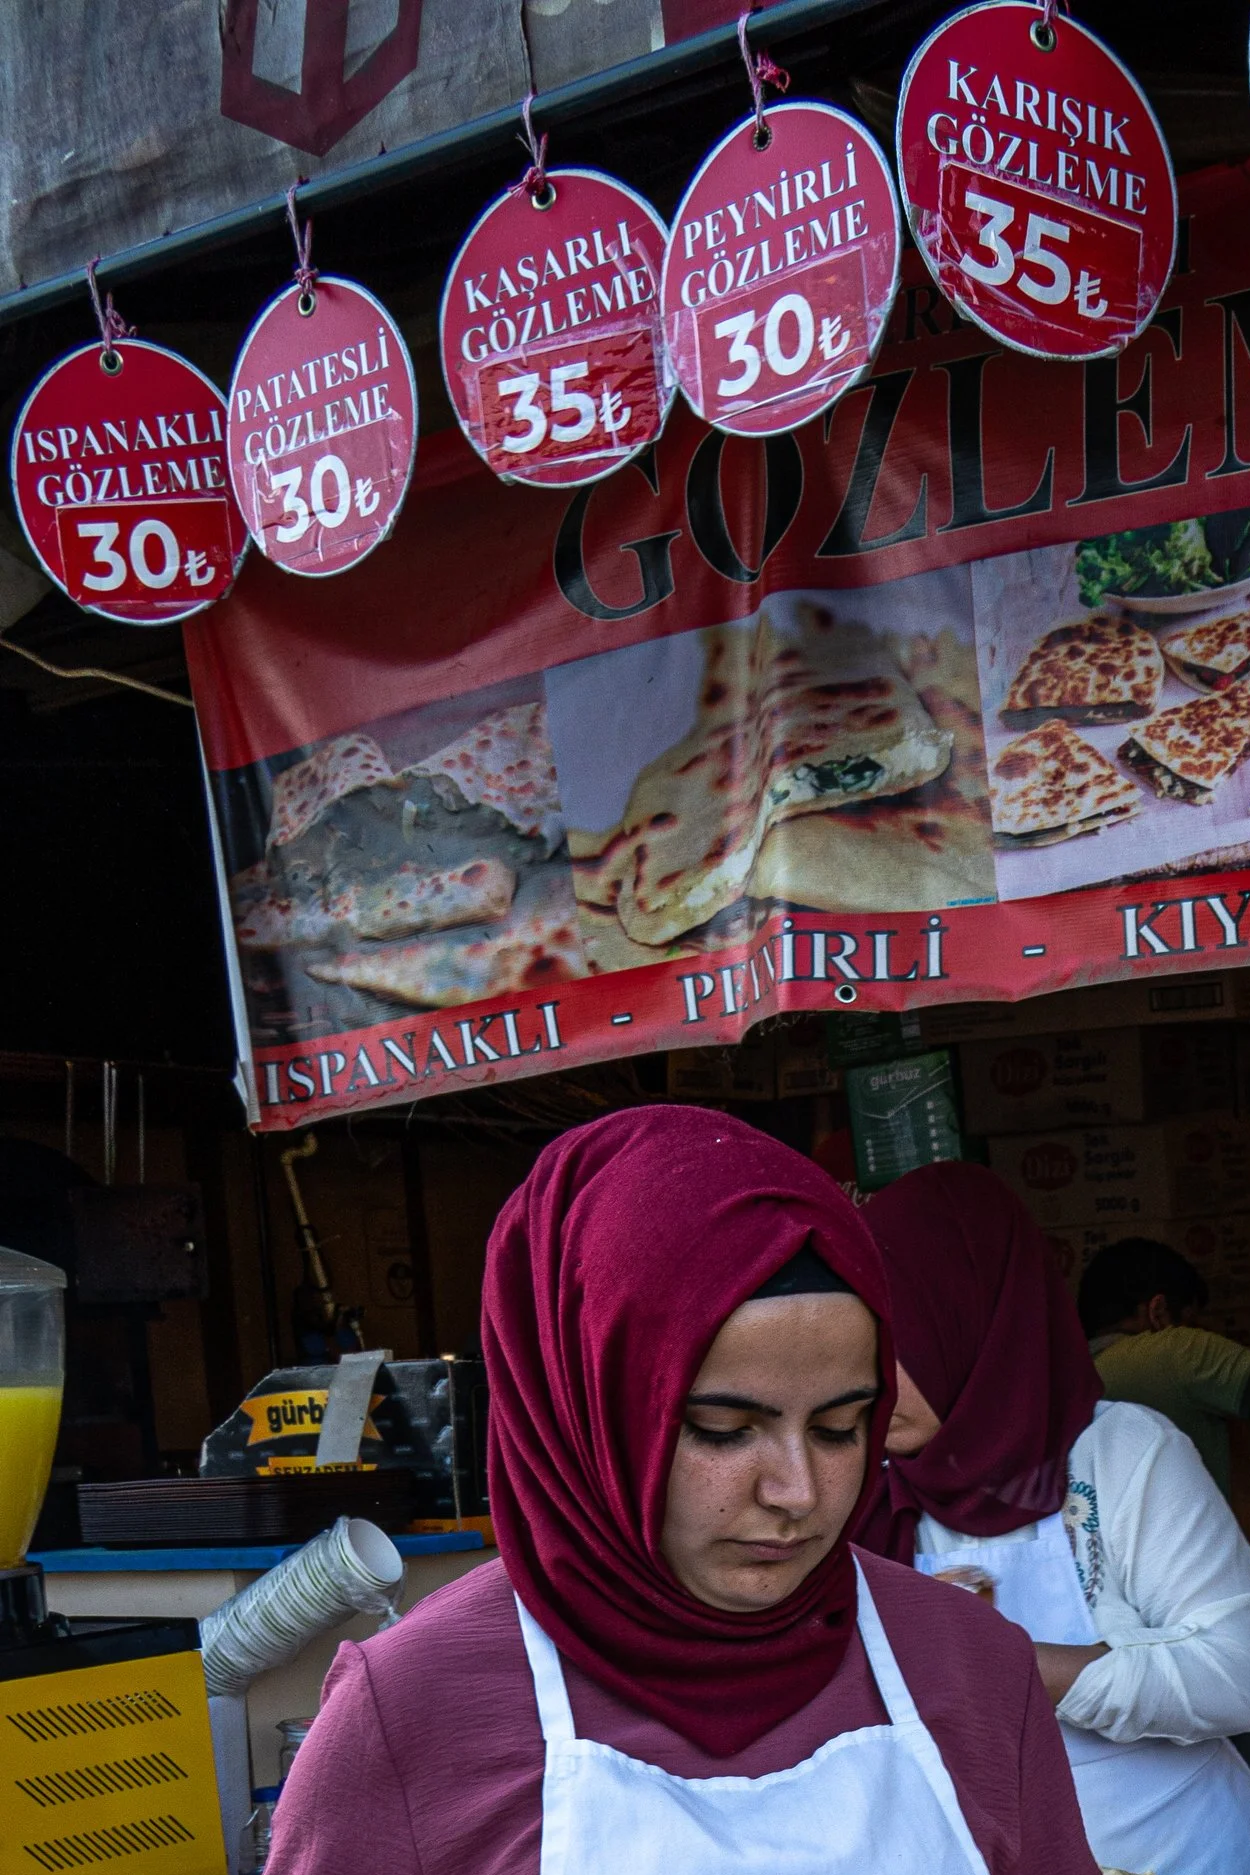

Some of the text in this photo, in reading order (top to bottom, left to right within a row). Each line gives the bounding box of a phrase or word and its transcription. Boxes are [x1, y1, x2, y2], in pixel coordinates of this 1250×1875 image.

[948, 60, 1131, 157] KARIŞIK
[682, 143, 857, 260] PEYNİRLİ
[927, 112, 1147, 215] GÖZLEME
[463, 222, 632, 315] KAŞARLI
[680, 200, 869, 309] GÖZLEME
[960, 191, 1107, 318] 35₺
[461, 265, 655, 363] GÖZLEME
[715, 292, 850, 397] 30₺
[236, 327, 390, 422] PATATESLİ
[498, 361, 632, 454] 35₺
[24, 407, 225, 465] ISPANAKLI
[244, 384, 391, 465] GÖZLEME
[37, 455, 226, 507] GÖZLEME
[270, 454, 380, 543] 30₺
[77, 519, 215, 592] 30₺
[258, 1000, 567, 1107] ISPANAKLI
[267, 1397, 328, 1434] gürb
